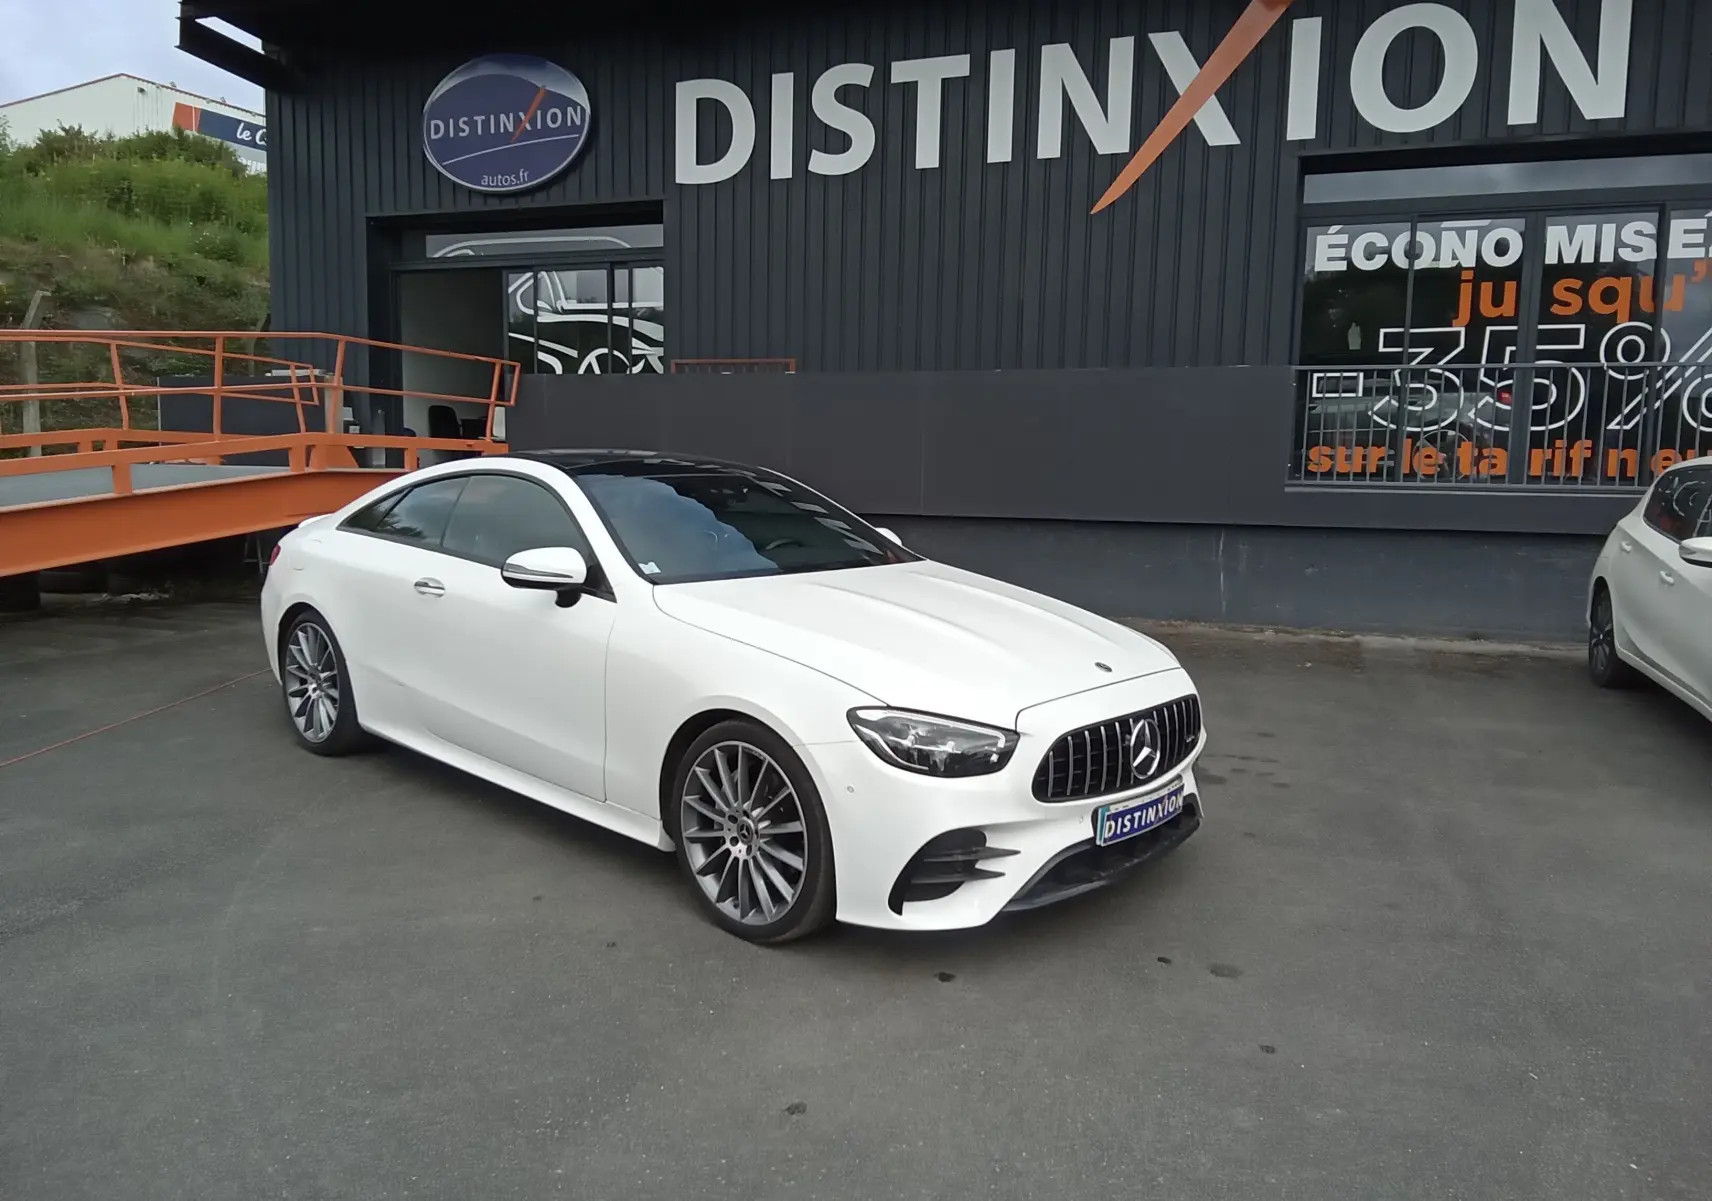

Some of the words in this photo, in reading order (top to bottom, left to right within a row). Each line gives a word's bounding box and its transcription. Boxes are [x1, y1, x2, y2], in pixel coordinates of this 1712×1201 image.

[430, 87, 581, 143] DISTINXION
[674, 0, 1633, 213] DISTINXION
[481, 168, 529, 186] autos.fr
[1307, 444, 1389, 474] sur
[1403, 438, 1442, 476] le
[1104, 791, 1184, 839] DISTINXION
